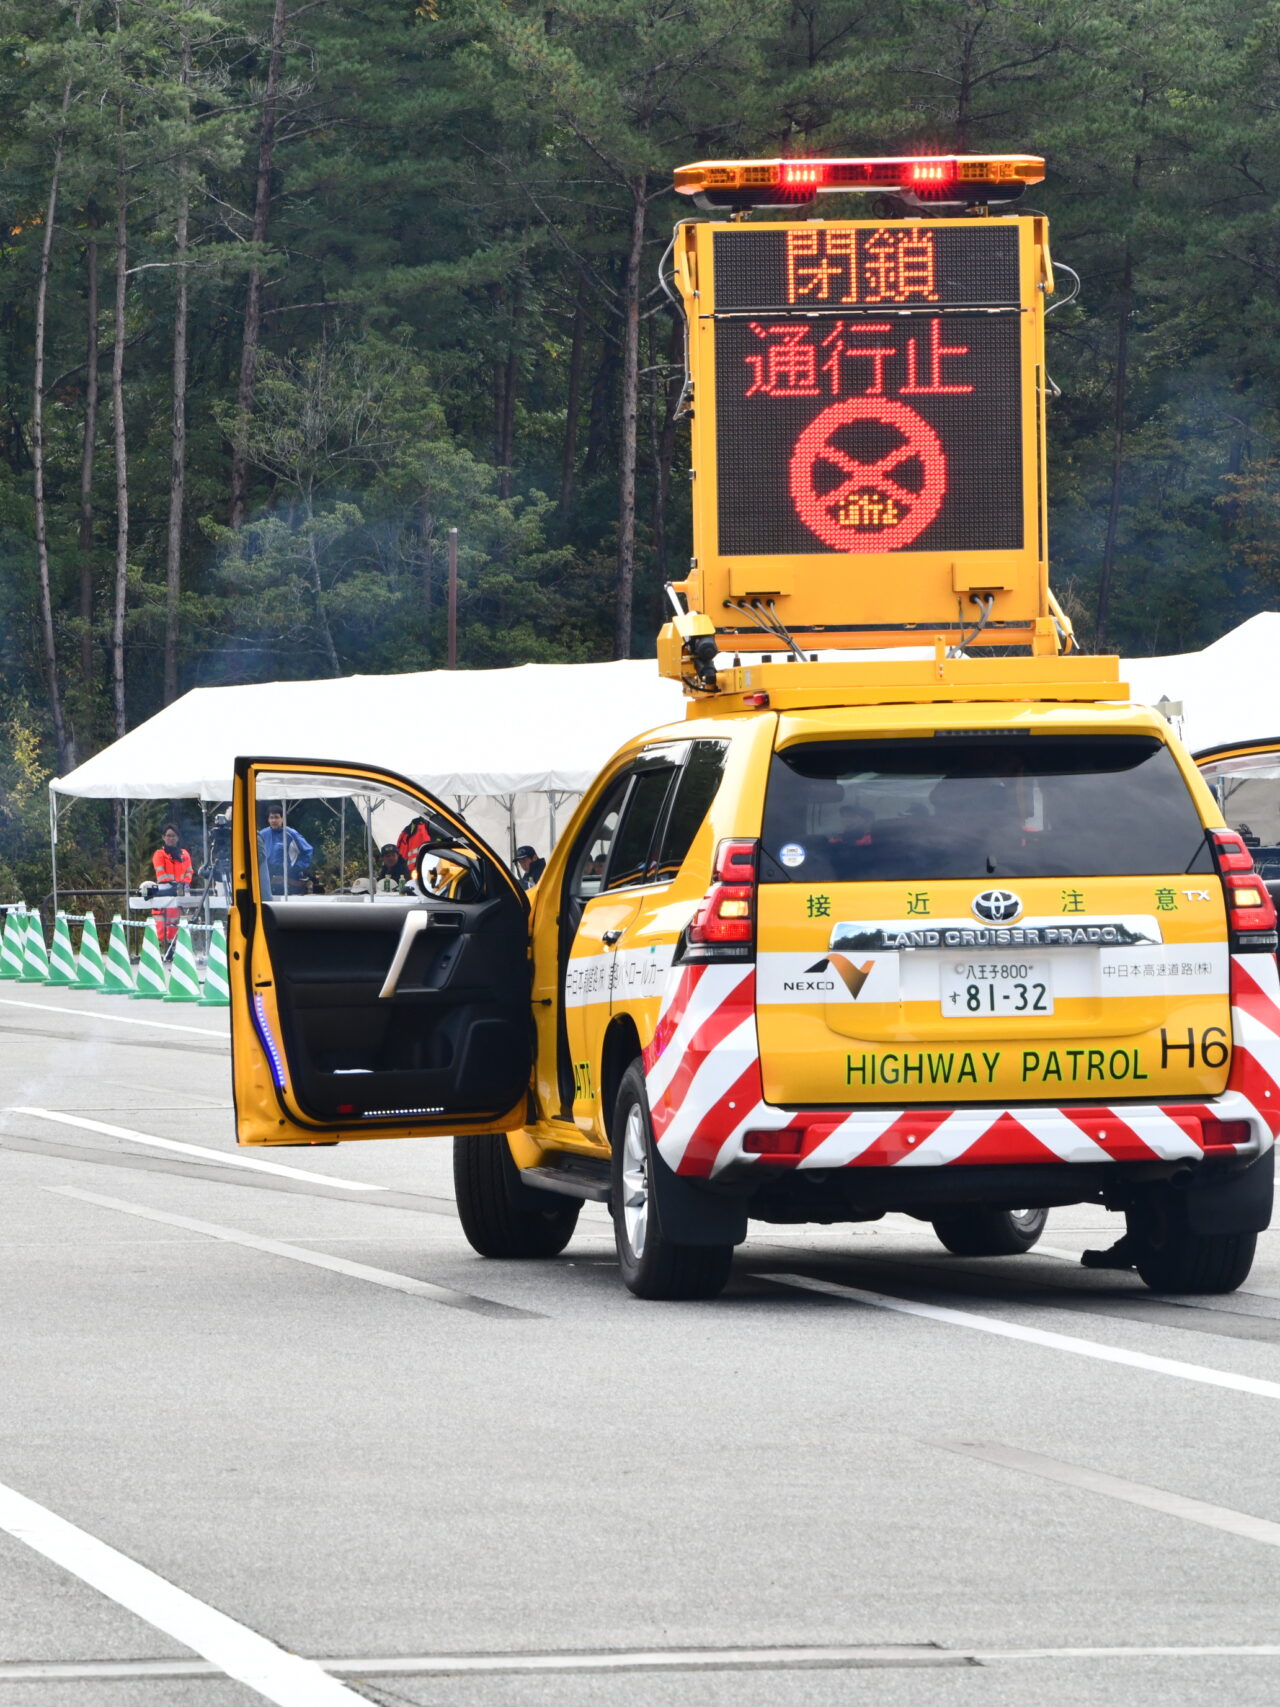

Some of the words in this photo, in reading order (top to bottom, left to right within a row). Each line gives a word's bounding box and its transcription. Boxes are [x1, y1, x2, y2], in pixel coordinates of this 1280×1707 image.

[786, 228, 939, 304] 閉鎖
[745, 318, 975, 397] 通行止
[1182, 890, 1211, 902] TX
[881, 931, 940, 947] LAND
[945, 929, 1039, 945] CRUISER
[1044, 926, 1117, 944] PRADO
[1103, 962, 1212, 978] 中日本高速道路(株)
[783, 981, 835, 991] NEXCO
[966, 983, 1047, 1012] 81-32
[1160, 1026, 1229, 1069] H6
[846, 1052, 1001, 1085] HIGHWAY
[1022, 1049, 1148, 1082] PATROL
